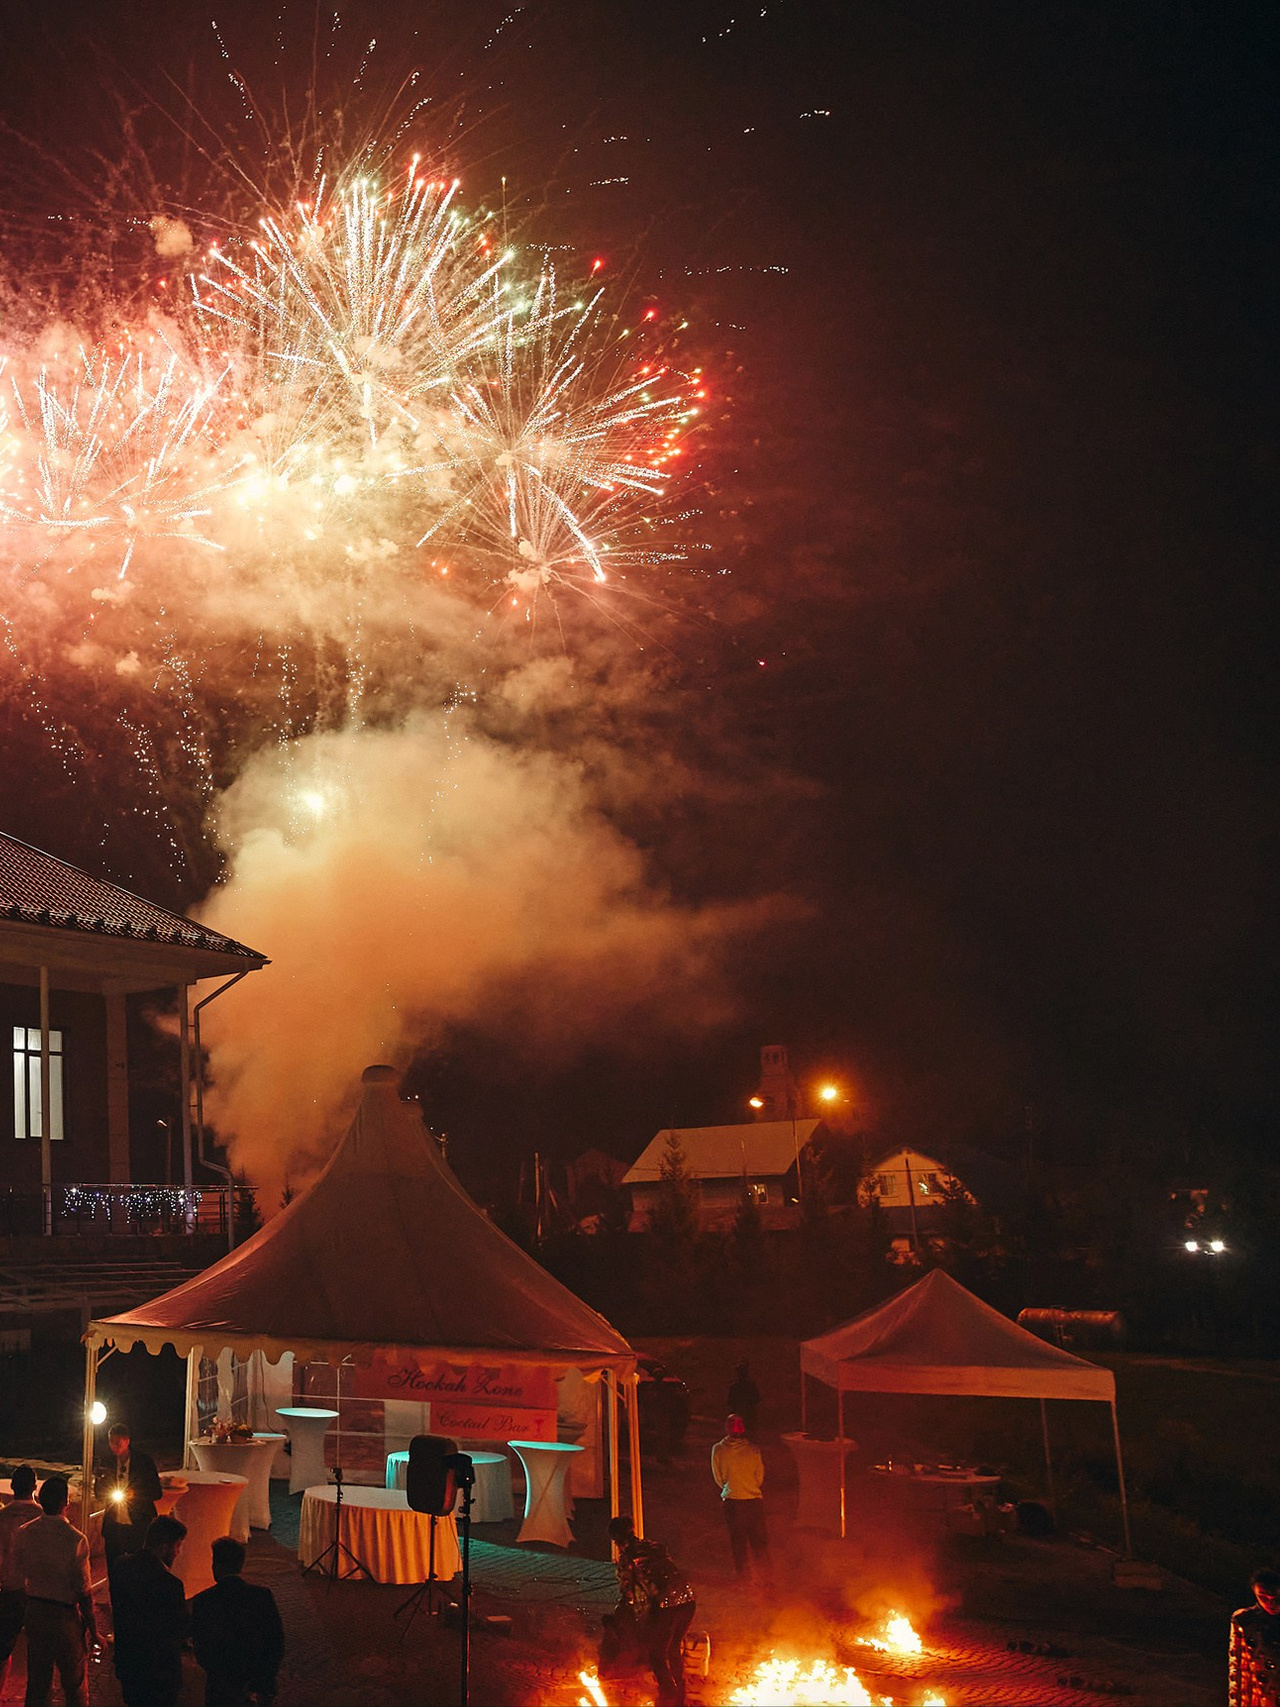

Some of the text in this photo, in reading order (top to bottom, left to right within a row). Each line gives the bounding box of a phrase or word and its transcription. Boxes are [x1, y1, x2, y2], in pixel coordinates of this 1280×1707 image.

[387, 1368, 524, 1397] Hookah Zone
[493, 1414, 530, 1433] Bar
